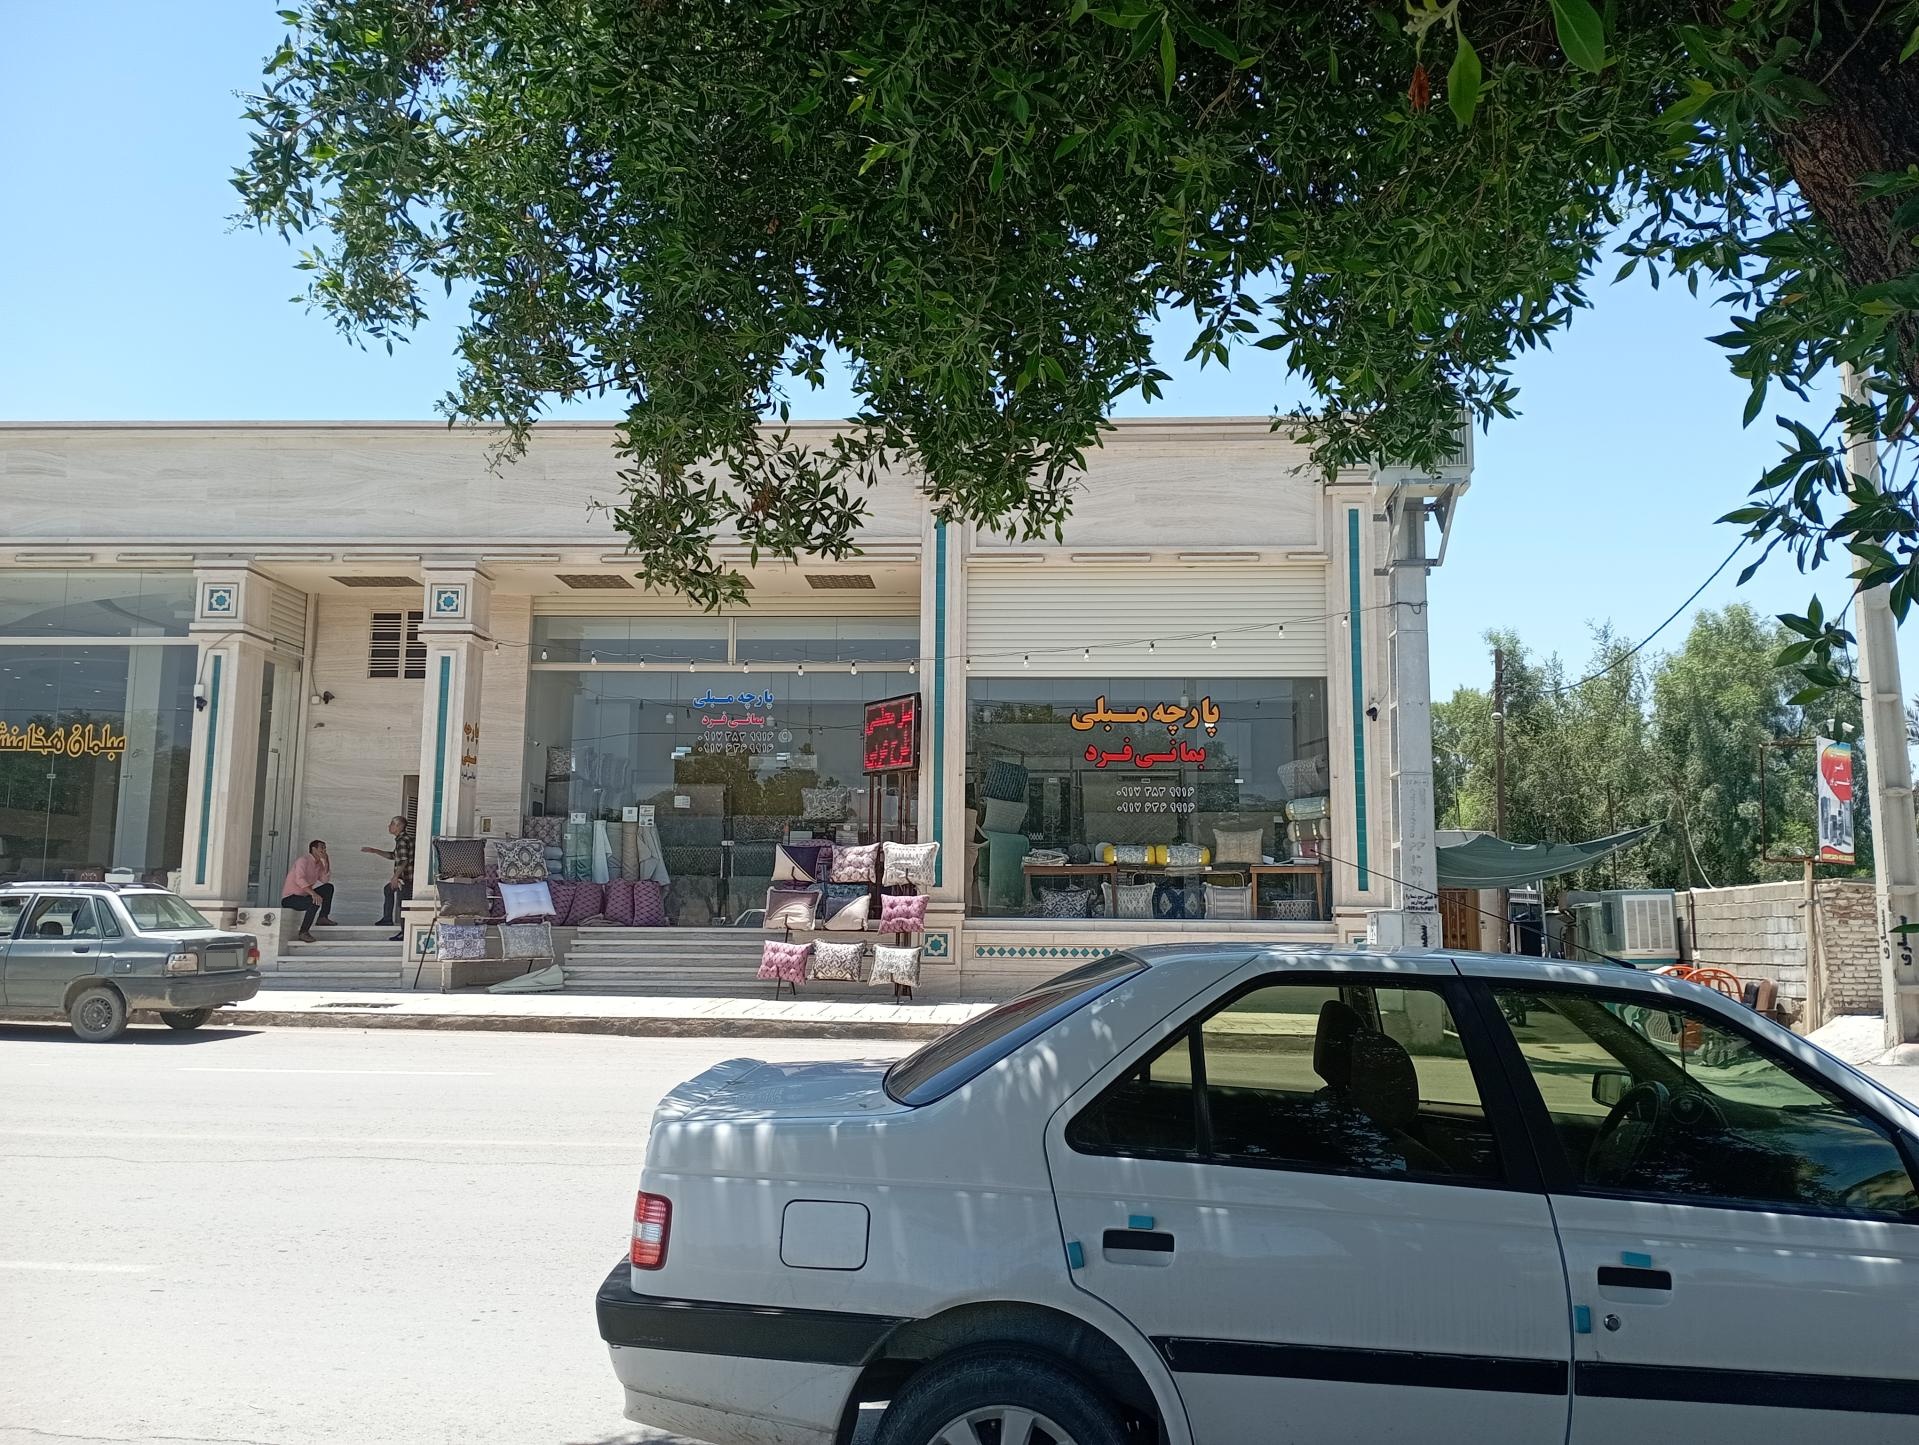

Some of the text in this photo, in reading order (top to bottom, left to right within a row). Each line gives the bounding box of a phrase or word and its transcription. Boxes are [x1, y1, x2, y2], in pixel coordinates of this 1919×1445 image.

[692, 688, 774, 710] پارچه مبلی
[1070, 695, 1221, 738] پارچه مبلی
[1084, 736, 1207, 770] بمانی فرد
[1897, 915, 1913, 966] سساری
